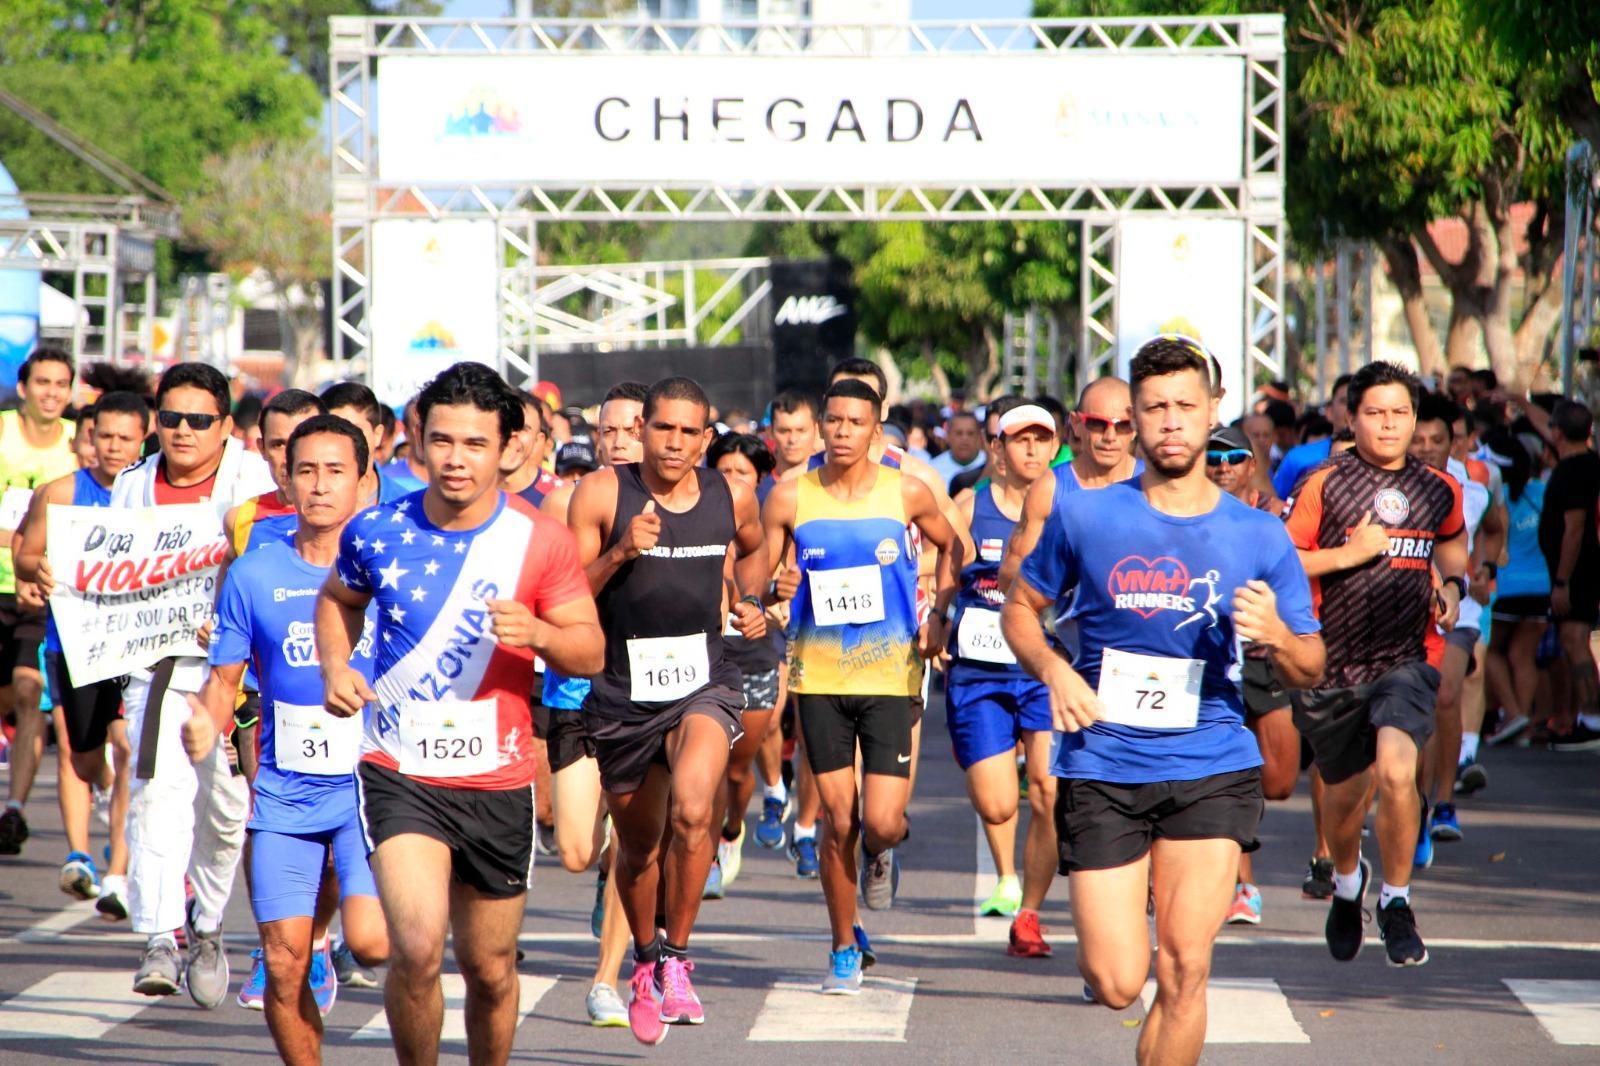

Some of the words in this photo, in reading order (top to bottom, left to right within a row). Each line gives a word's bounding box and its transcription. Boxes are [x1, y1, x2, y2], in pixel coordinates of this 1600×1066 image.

[594, 96, 983, 142] CHEGADA
[153, 524, 193, 551] não
[1386, 537, 1433, 558] URAS
[825, 593, 872, 612] 1418
[1115, 593, 1196, 613] RUNNERS
[135, 607, 163, 629] SOU
[168, 605, 188, 624] DA
[192, 601, 214, 620] PA
[971, 633, 1003, 649] 826
[286, 641, 314, 663] tv
[645, 664, 696, 687] 1619
[1135, 690, 1166, 710] 72
[302, 739, 329, 759] 31
[417, 736, 483, 760] 1520
